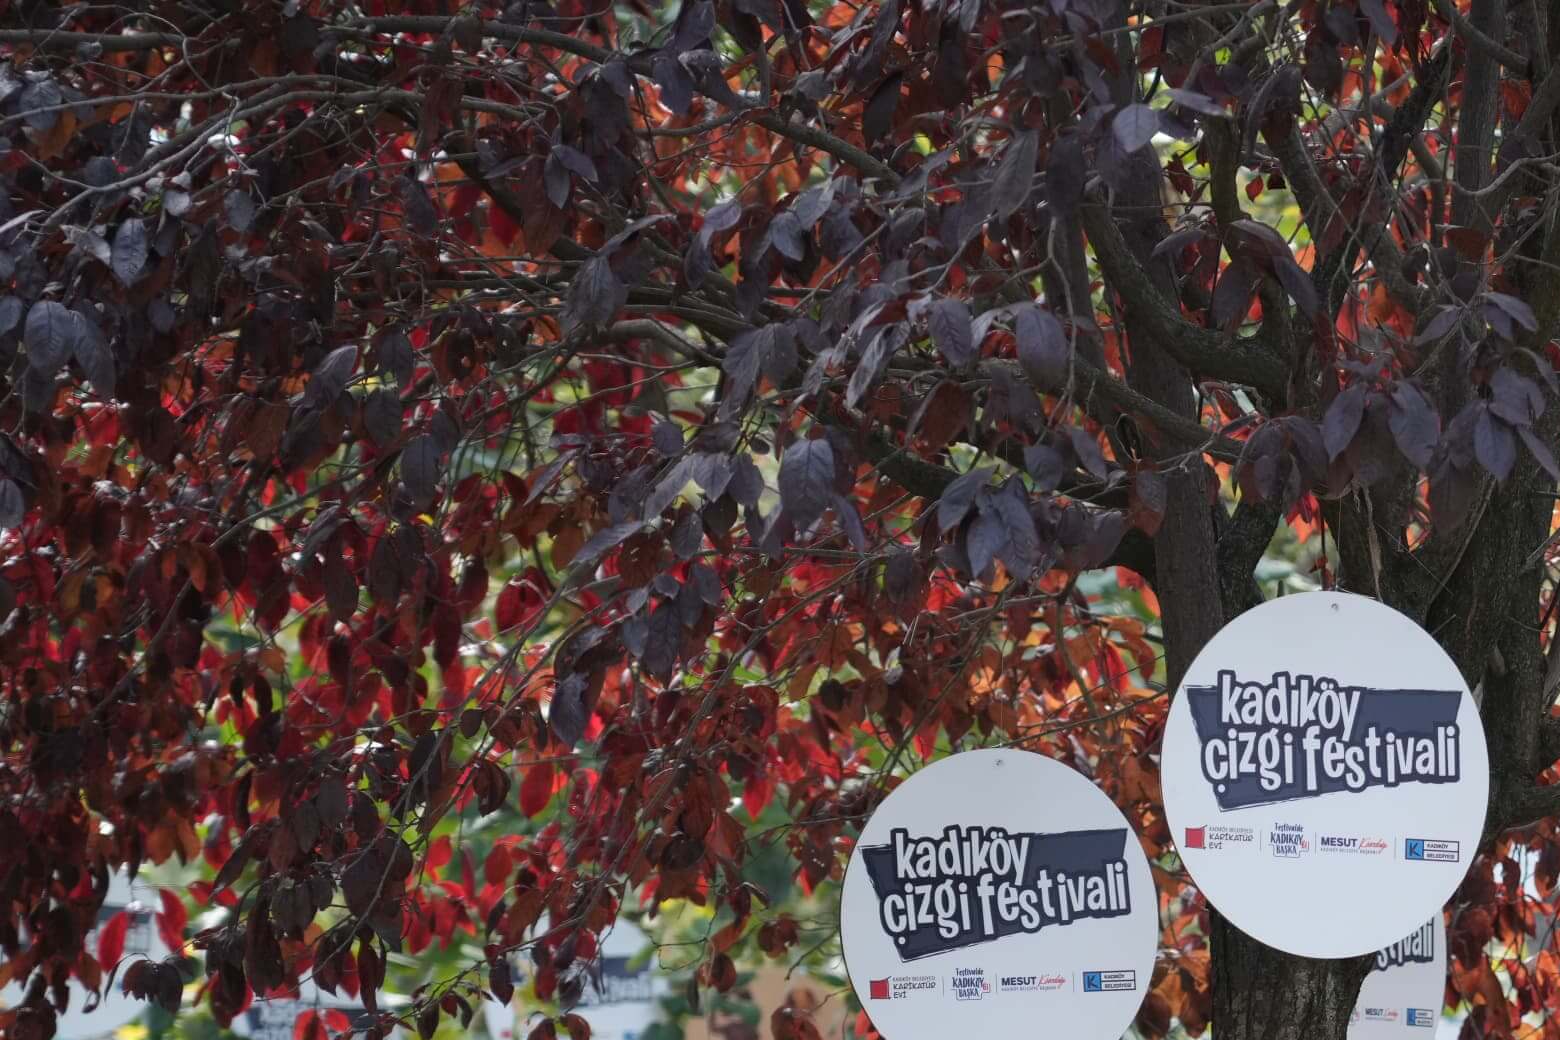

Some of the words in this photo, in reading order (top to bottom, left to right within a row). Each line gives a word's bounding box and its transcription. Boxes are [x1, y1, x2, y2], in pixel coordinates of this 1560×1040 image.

[1221, 673, 1361, 741] kadıköy
[1205, 728, 1294, 793] çizgi
[1302, 726, 1456, 791] festivali
[895, 829, 1030, 886] kadıköy
[1320, 836, 1358, 848] MESUT
[883, 881, 972, 945] çizgi
[977, 861, 1127, 936] festivali
[1001, 976, 1037, 987] MESUT
